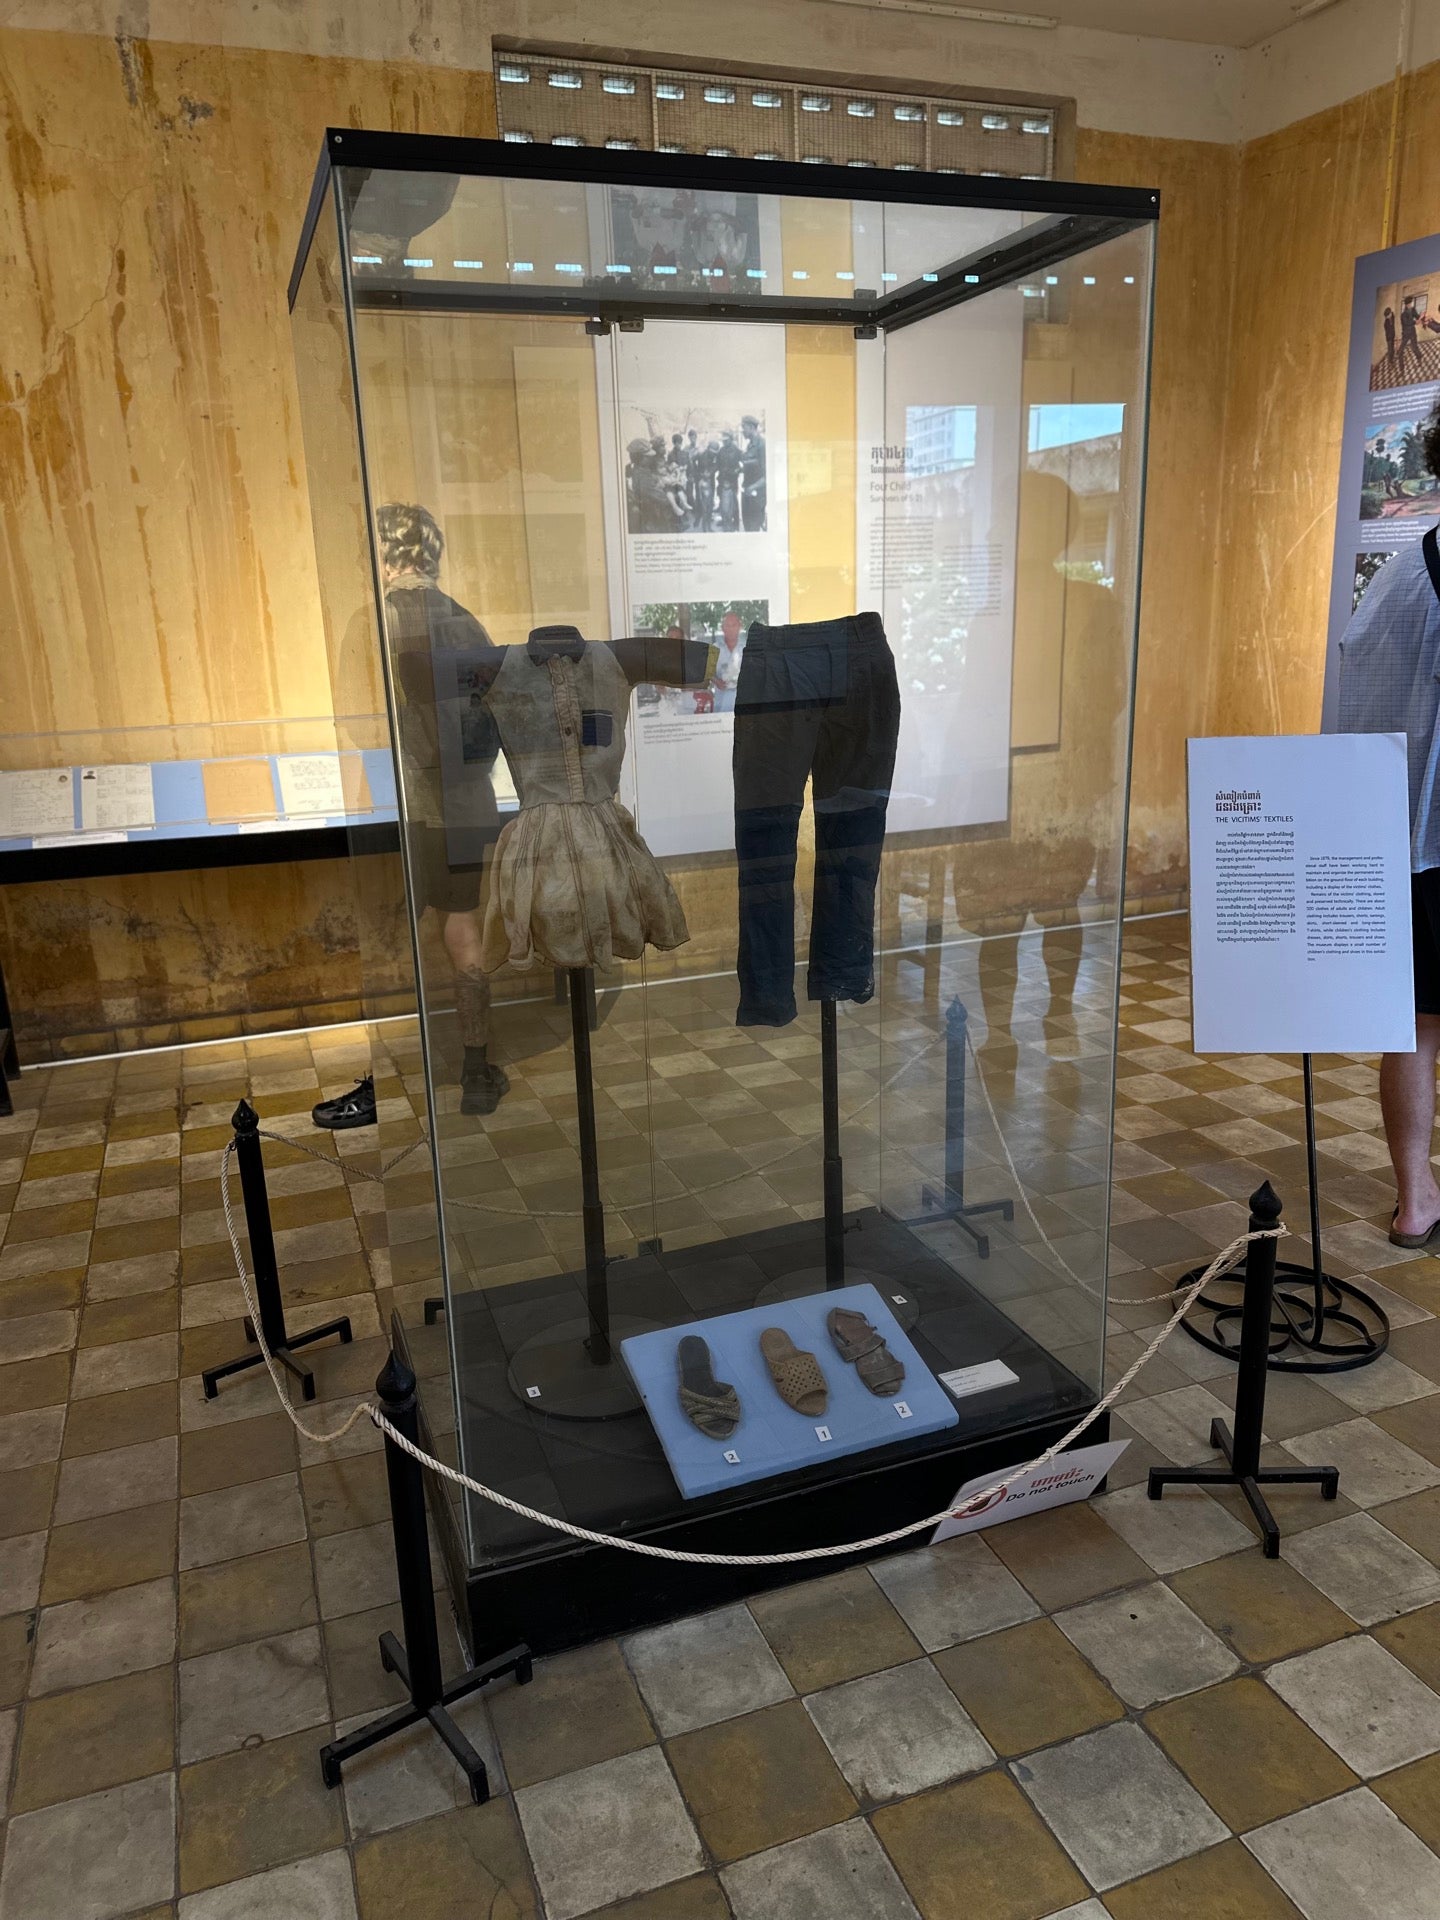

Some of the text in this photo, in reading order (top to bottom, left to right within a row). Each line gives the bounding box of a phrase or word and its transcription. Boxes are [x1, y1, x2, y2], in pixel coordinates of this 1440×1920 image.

[870, 481, 887, 491] Four
[1216, 802, 1261, 814] ជនរងគ្រោះ
[1005, 1474, 1095, 1502] Do not touch
